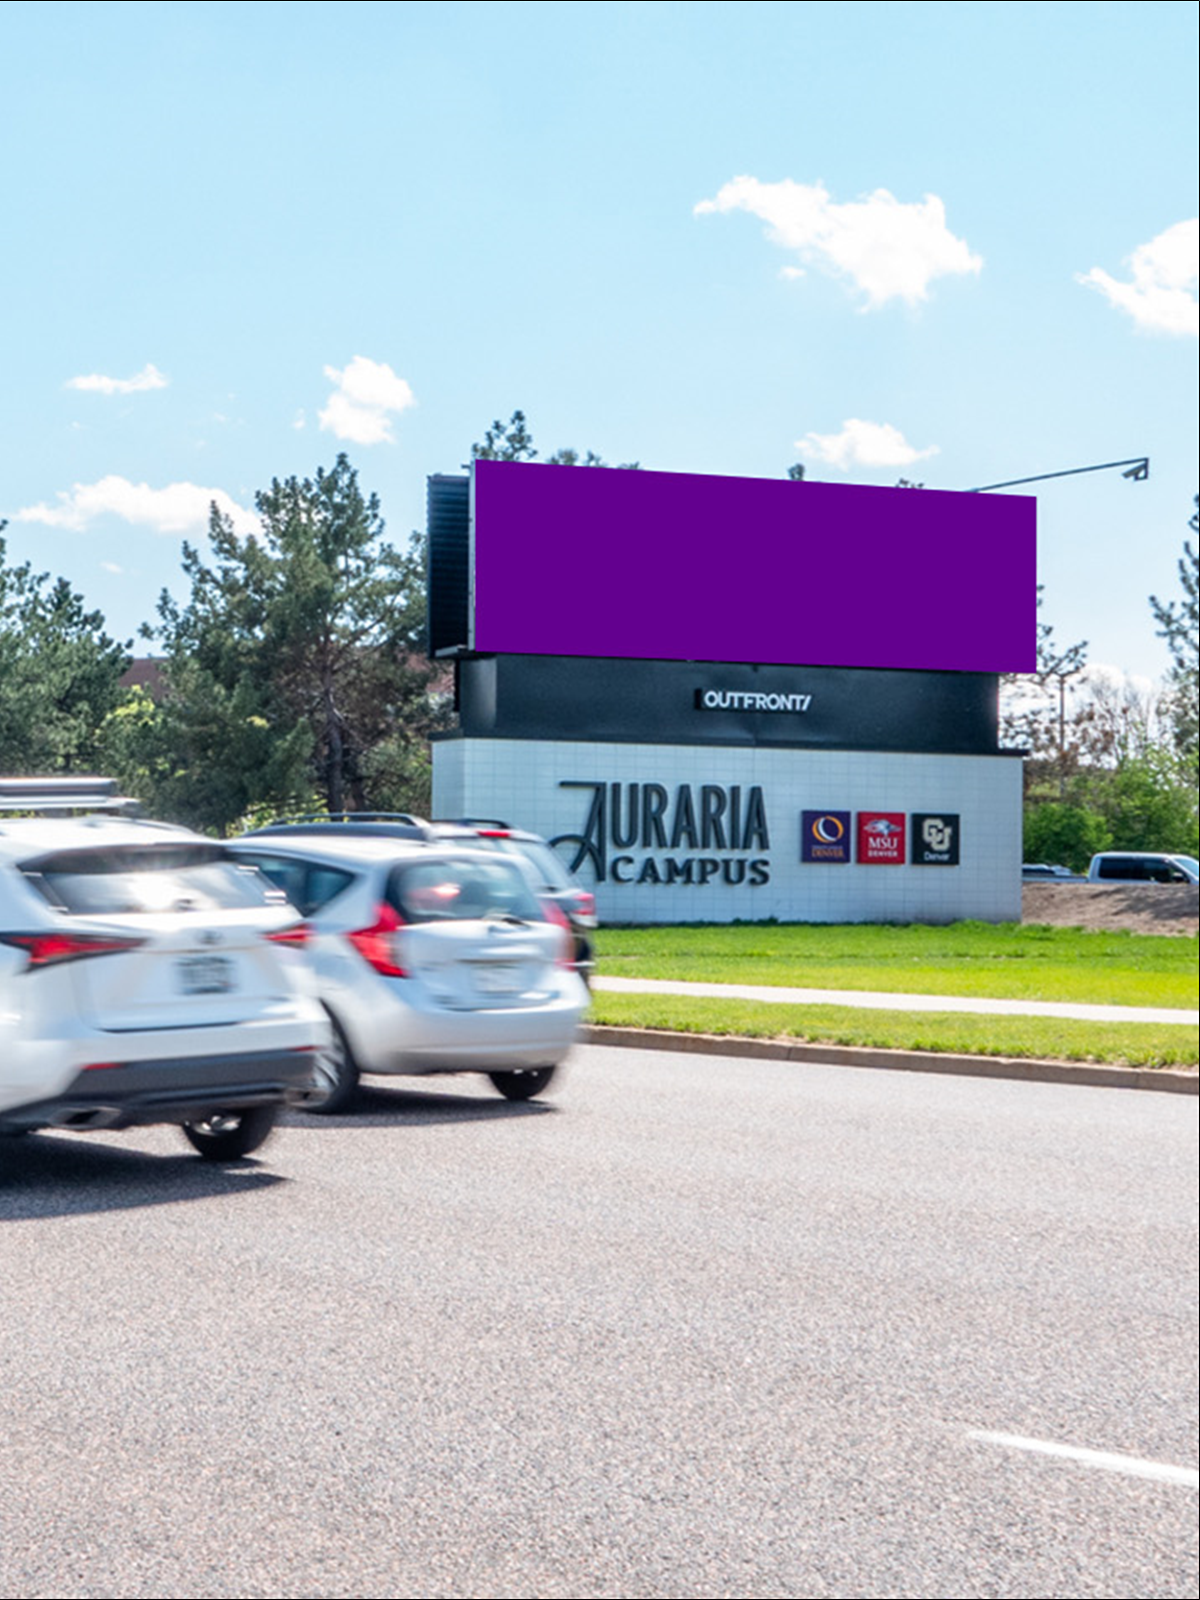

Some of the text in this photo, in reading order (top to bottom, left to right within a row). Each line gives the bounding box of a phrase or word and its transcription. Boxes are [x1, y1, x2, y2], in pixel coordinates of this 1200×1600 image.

[549, 781, 770, 882] AURARIA
[922, 818, 951, 851] CU
[868, 836, 898, 849] MSU
[867, 850, 898, 858] DENVER
[923, 851, 951, 861] Denver
[611, 855, 771, 885] CAMPUS
